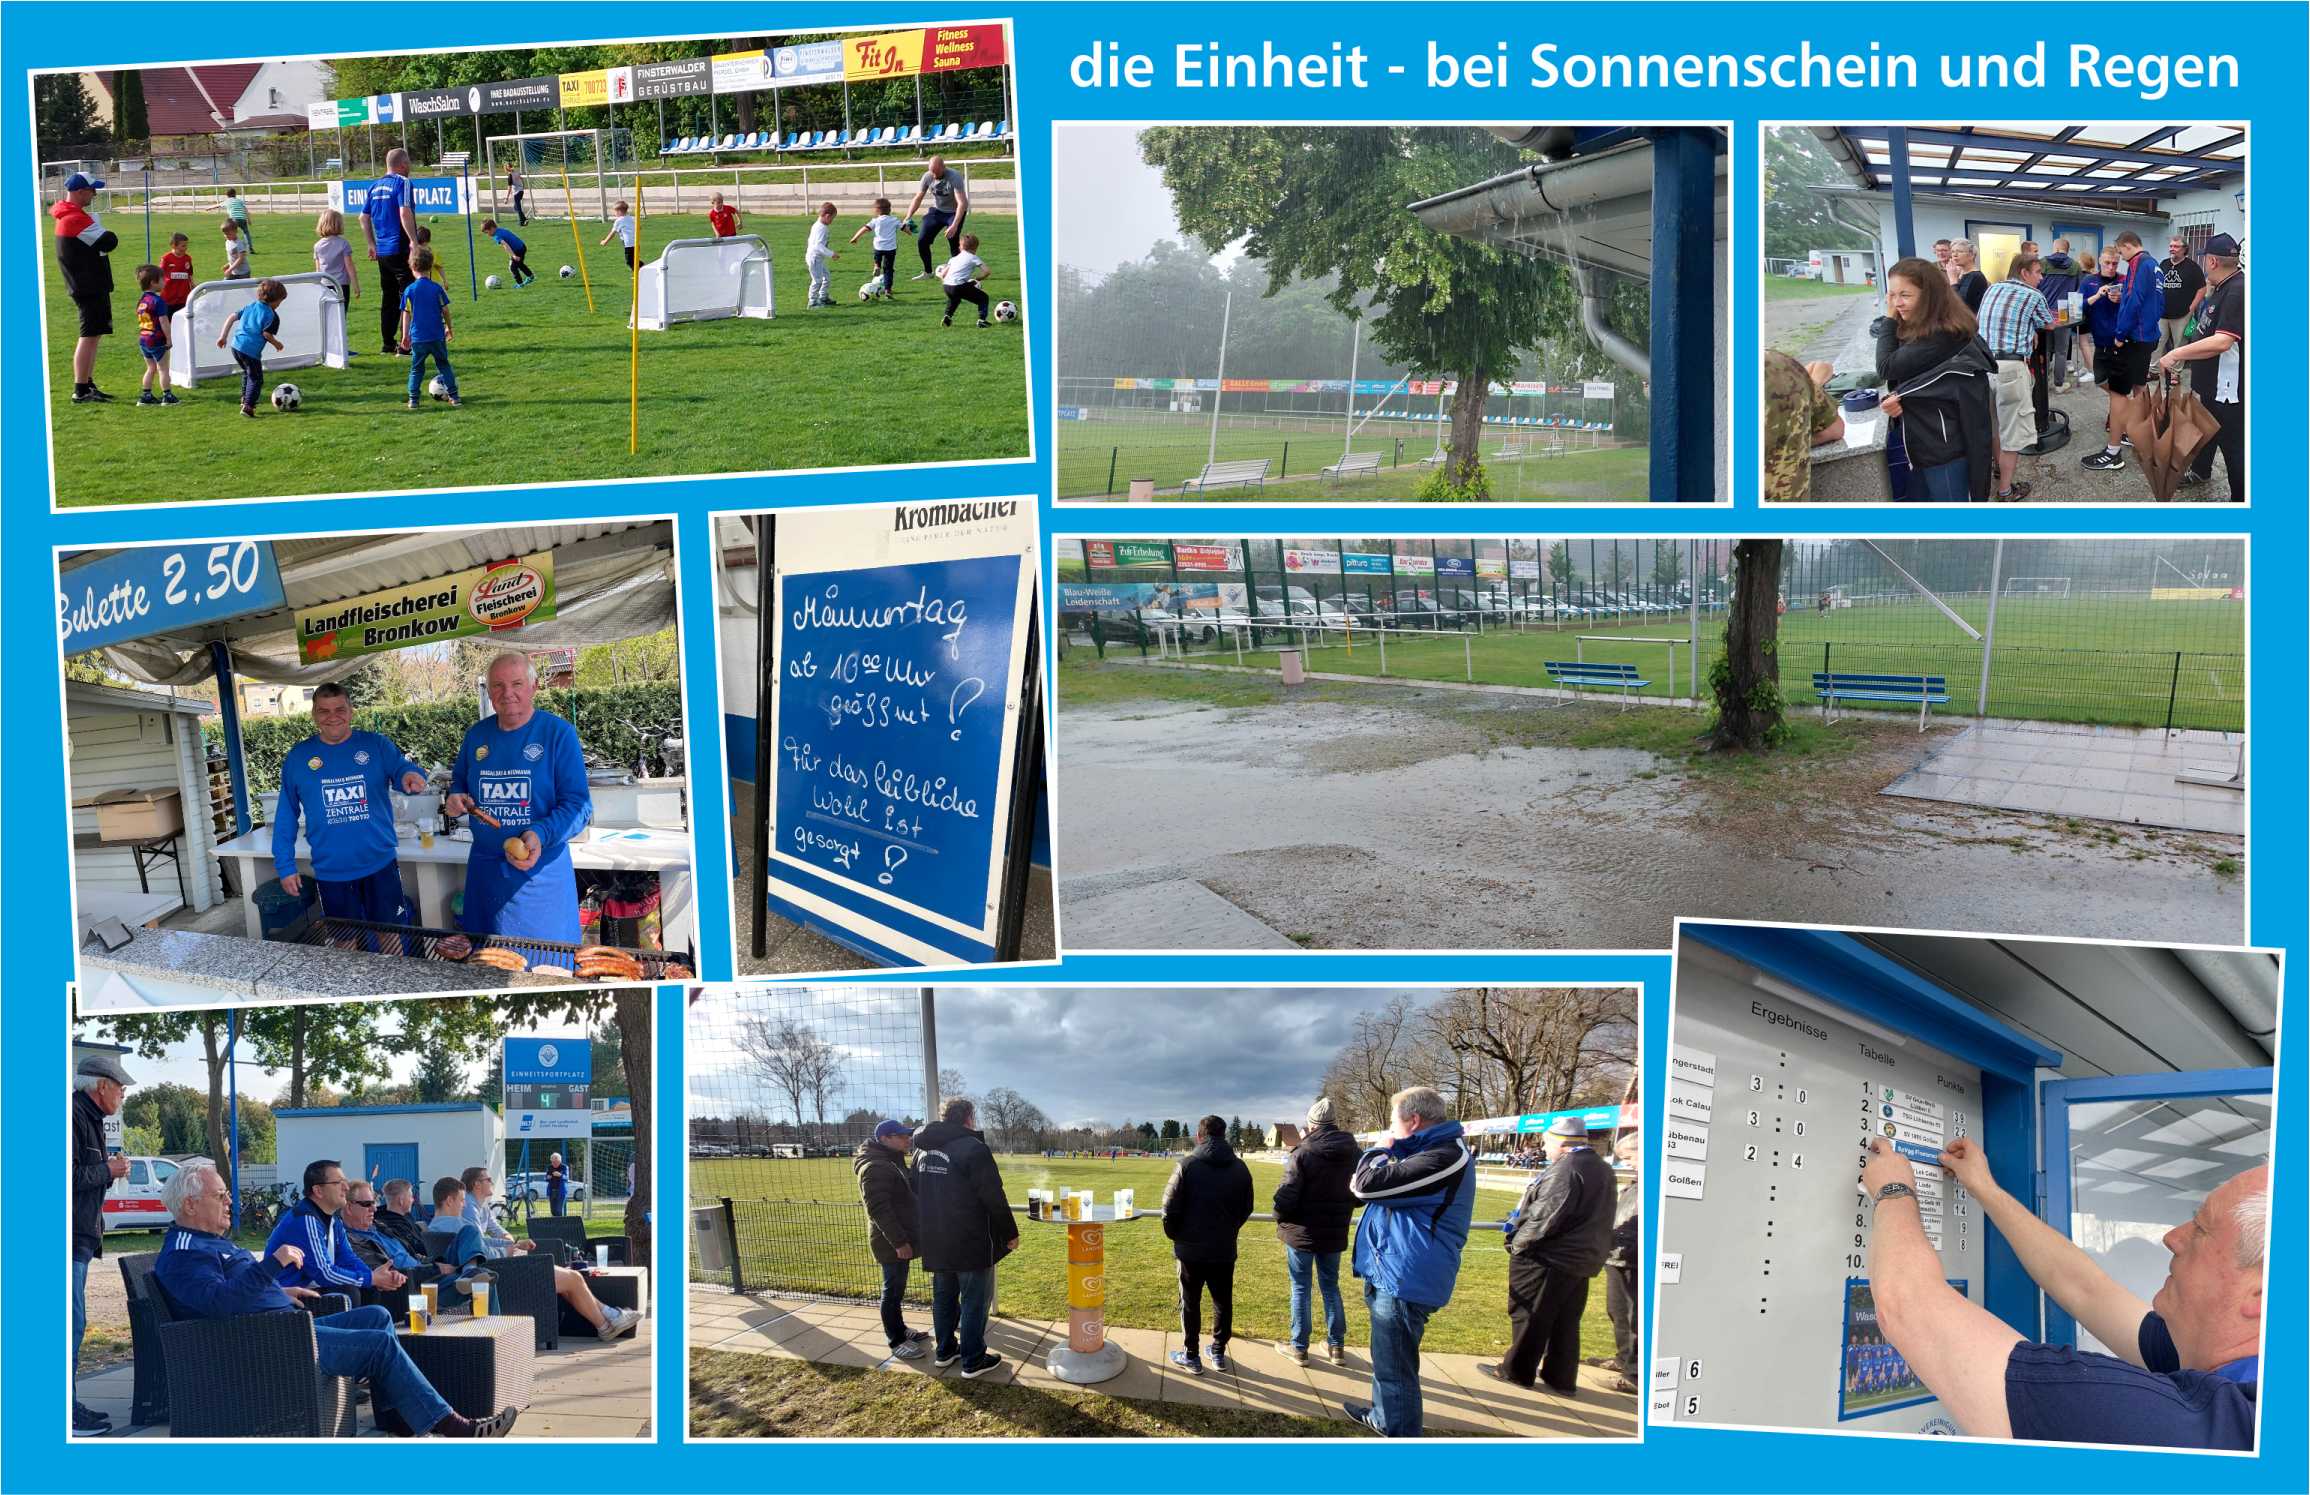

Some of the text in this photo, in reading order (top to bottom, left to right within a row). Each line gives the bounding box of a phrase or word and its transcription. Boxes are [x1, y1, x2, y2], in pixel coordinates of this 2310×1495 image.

[937, 28, 968, 41] Fitness
[856, 39, 880, 69] Fit
[936, 41, 975, 54] Wellness
[933, 56, 961, 68] Sauna
[637, 62, 706, 79] FINSTERWALDER
[490, 84, 549, 99] IHRE BADAUSSTELLUNG
[562, 79, 607, 95] TAXI 700733
[639, 80, 707, 96] GERÜSTBAU
[409, 95, 461, 114] WaschSalon
[60, 541, 259, 640] Bulette 2,50
[475, 572, 534, 602] Land
[476, 586, 537, 615] Fleischerei
[304, 585, 457, 635] Landfleischerei
[489, 604, 526, 620] Bronkow
[364, 614, 461, 647] Bronkow
[790, 651, 818, 679] ab
[885, 657, 936, 688] Uhr
[828, 756, 869, 789] das
[324, 785, 365, 802] TAXI
[481, 783, 528, 798] TAXI
[325, 804, 369, 818] ZENTRALE
[812, 784, 871, 823] Wohl
[794, 826, 861, 870] gesorgt
[1751, 1001, 1829, 1041] Ergebnisse
[1858, 1042, 1896, 1067] Tabelle
[1672, 1058, 1715, 1075] ngerstadt
[511, 1071, 585, 1079] EINHEITSPORTPLATZ
[506, 1084, 532, 1093] HEIM
[568, 1084, 590, 1093] GAST
[1753, 1077, 1806, 1103] 3 0
[1863, 1081, 1873, 1096] 1.
[1937, 1074, 1965, 1095] Punkte
[1671, 1096, 1711, 1111] ok Calau
[1861, 1099, 1872, 1114] 2.
[104, 1120, 120, 1132] ast
[1749, 1112, 1804, 1135] 3 0
[1860, 1118, 1871, 1132] 3.
[1859, 1137, 1871, 1150] 4.
[1747, 1146, 1802, 1168] 2 4
[1668, 1173, 1702, 1187] Golßen
[1857, 1194, 1868, 1208] 7.
[1856, 1214, 1867, 1228] 8.
[1961, 1222, 1966, 1233] 9
[1854, 1233, 1866, 1248] 9.
[1960, 1240, 1966, 1251] 8
[1846, 1254, 1865, 1269] 10.
[1855, 1311, 1878, 1321] Wasc
[1690, 1361, 1699, 1378] 6
[1688, 1397, 1698, 1415] 5
[1919, 1416, 1957, 1435] VEREINIGUN
